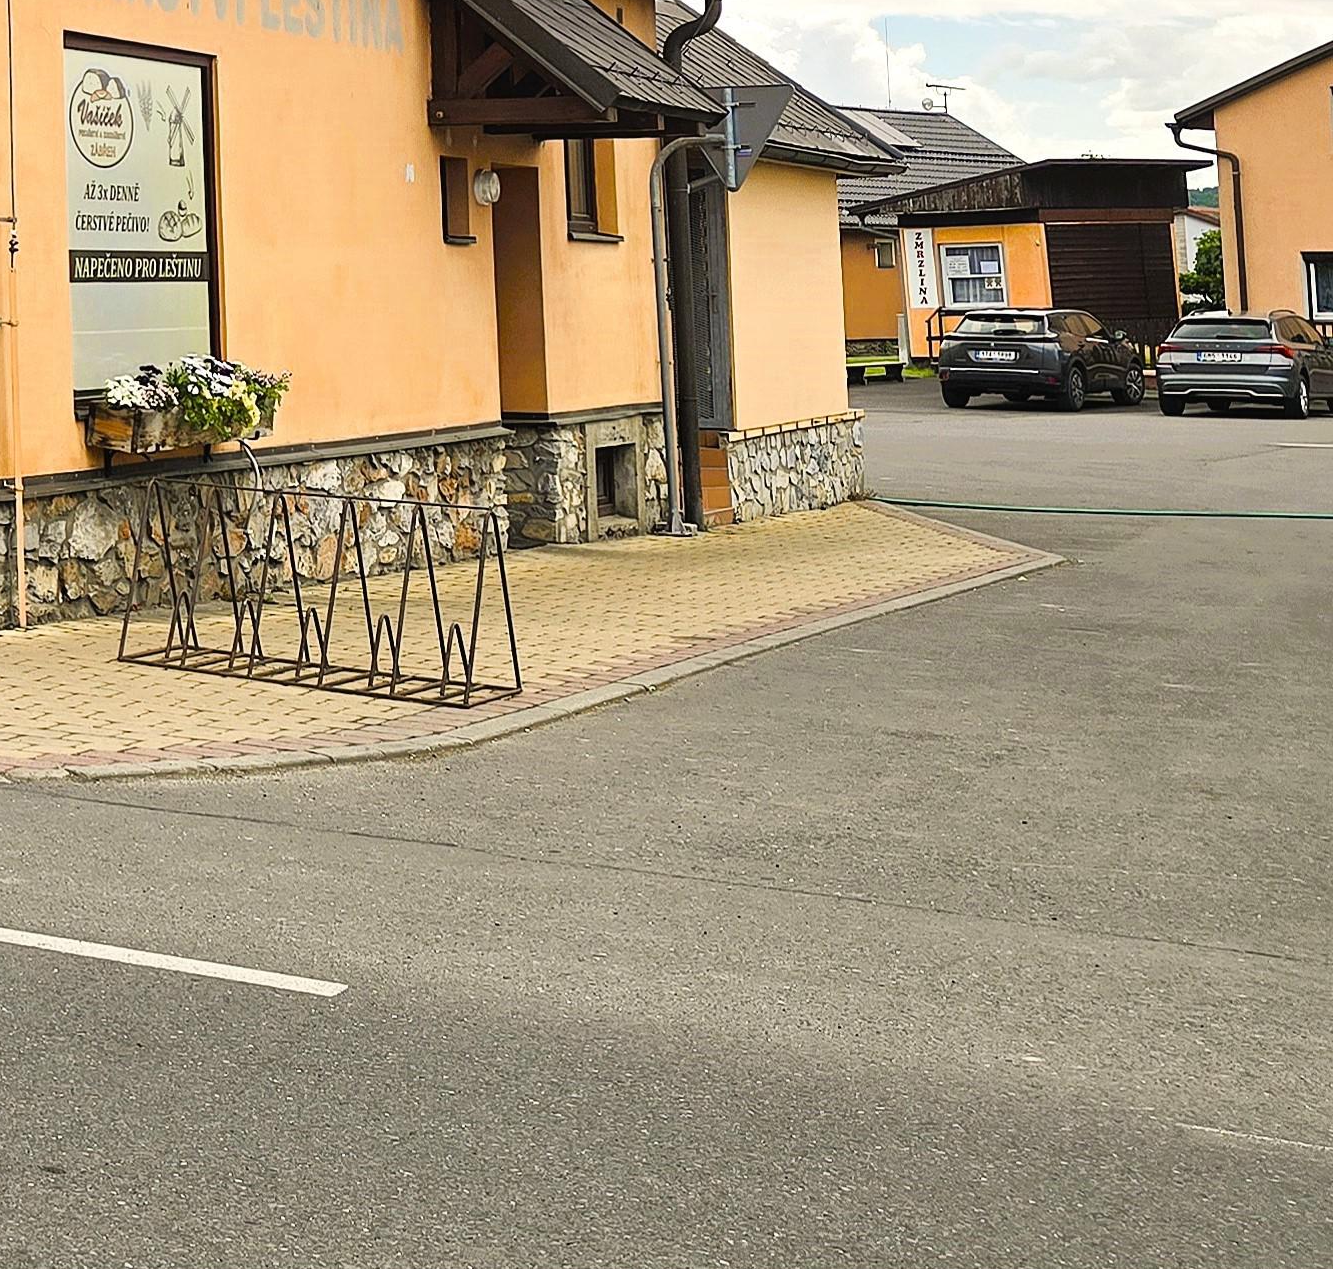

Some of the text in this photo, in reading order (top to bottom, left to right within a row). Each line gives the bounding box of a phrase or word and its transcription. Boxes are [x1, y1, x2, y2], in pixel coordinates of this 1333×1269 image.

[77, 98, 123, 128] Vašíček
[83, 180, 141, 202] AŽ 3x DENNĚ
[75, 210, 150, 233] ČERSTVÉ PEČIVO!
[74, 253, 202, 278] NAPEČENO PRO LEŠTINU
[914, 232, 929, 305] ZMRZLINA
